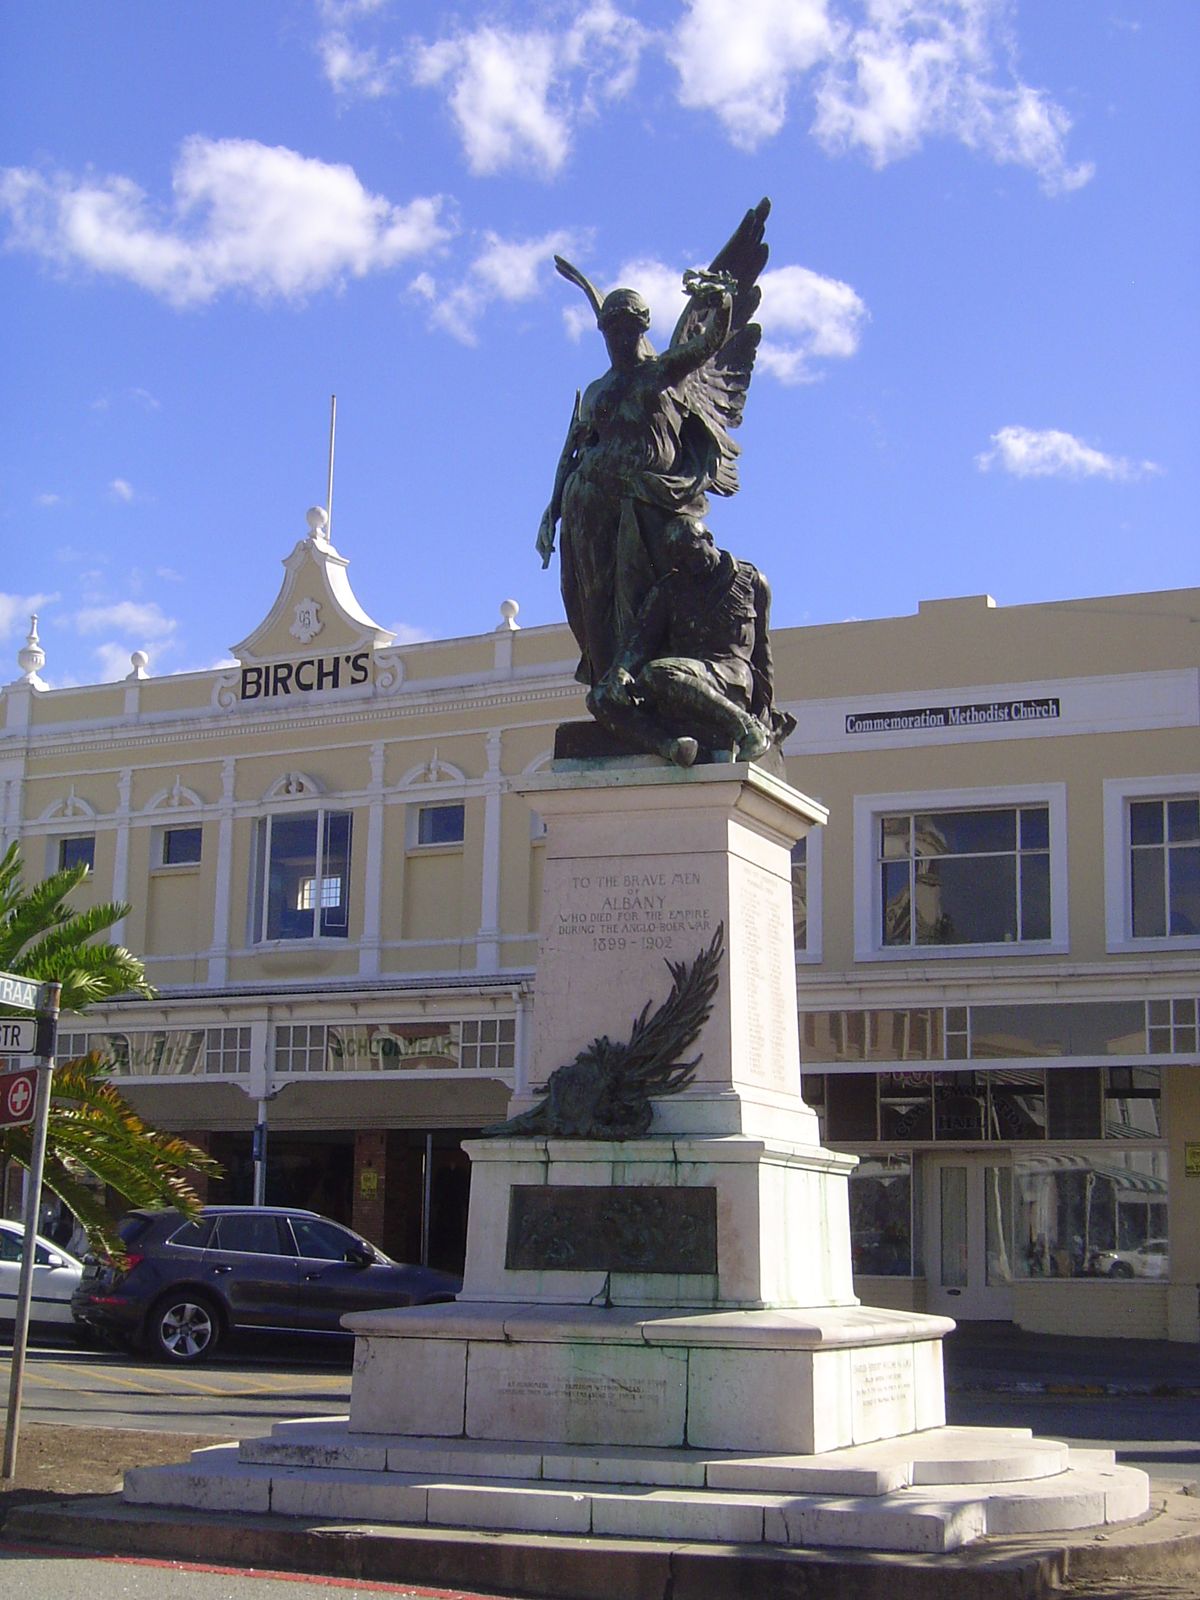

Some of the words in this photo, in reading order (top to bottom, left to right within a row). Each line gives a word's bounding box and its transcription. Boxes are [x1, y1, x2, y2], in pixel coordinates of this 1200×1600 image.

[241, 653, 369, 700] BIRCH'S
[846, 709, 944, 733] Commemoration
[948, 704, 1009, 725] Methodist
[1011, 700, 1058, 720] Church
[572, 877, 591, 889] TO
[598, 875, 618, 888] THE
[623, 874, 666, 887] BRAVE
[671, 872, 700, 885] MEN
[602, 896, 666, 911] ALBANY
[559, 913, 587, 923] WHO
[590, 912, 612, 922] DIED
[617, 911, 638, 921] FOR
[645, 911, 662, 920] THE
[669, 909, 710, 920] EMPIRE
[558, 925, 595, 935] DURING
[600, 923, 619, 934] THE
[688, 920, 711, 931] WAR
[592, 937, 626, 950] 1899
[641, 936, 673, 949] 1902
[0, 1025, 21, 1046] TR
